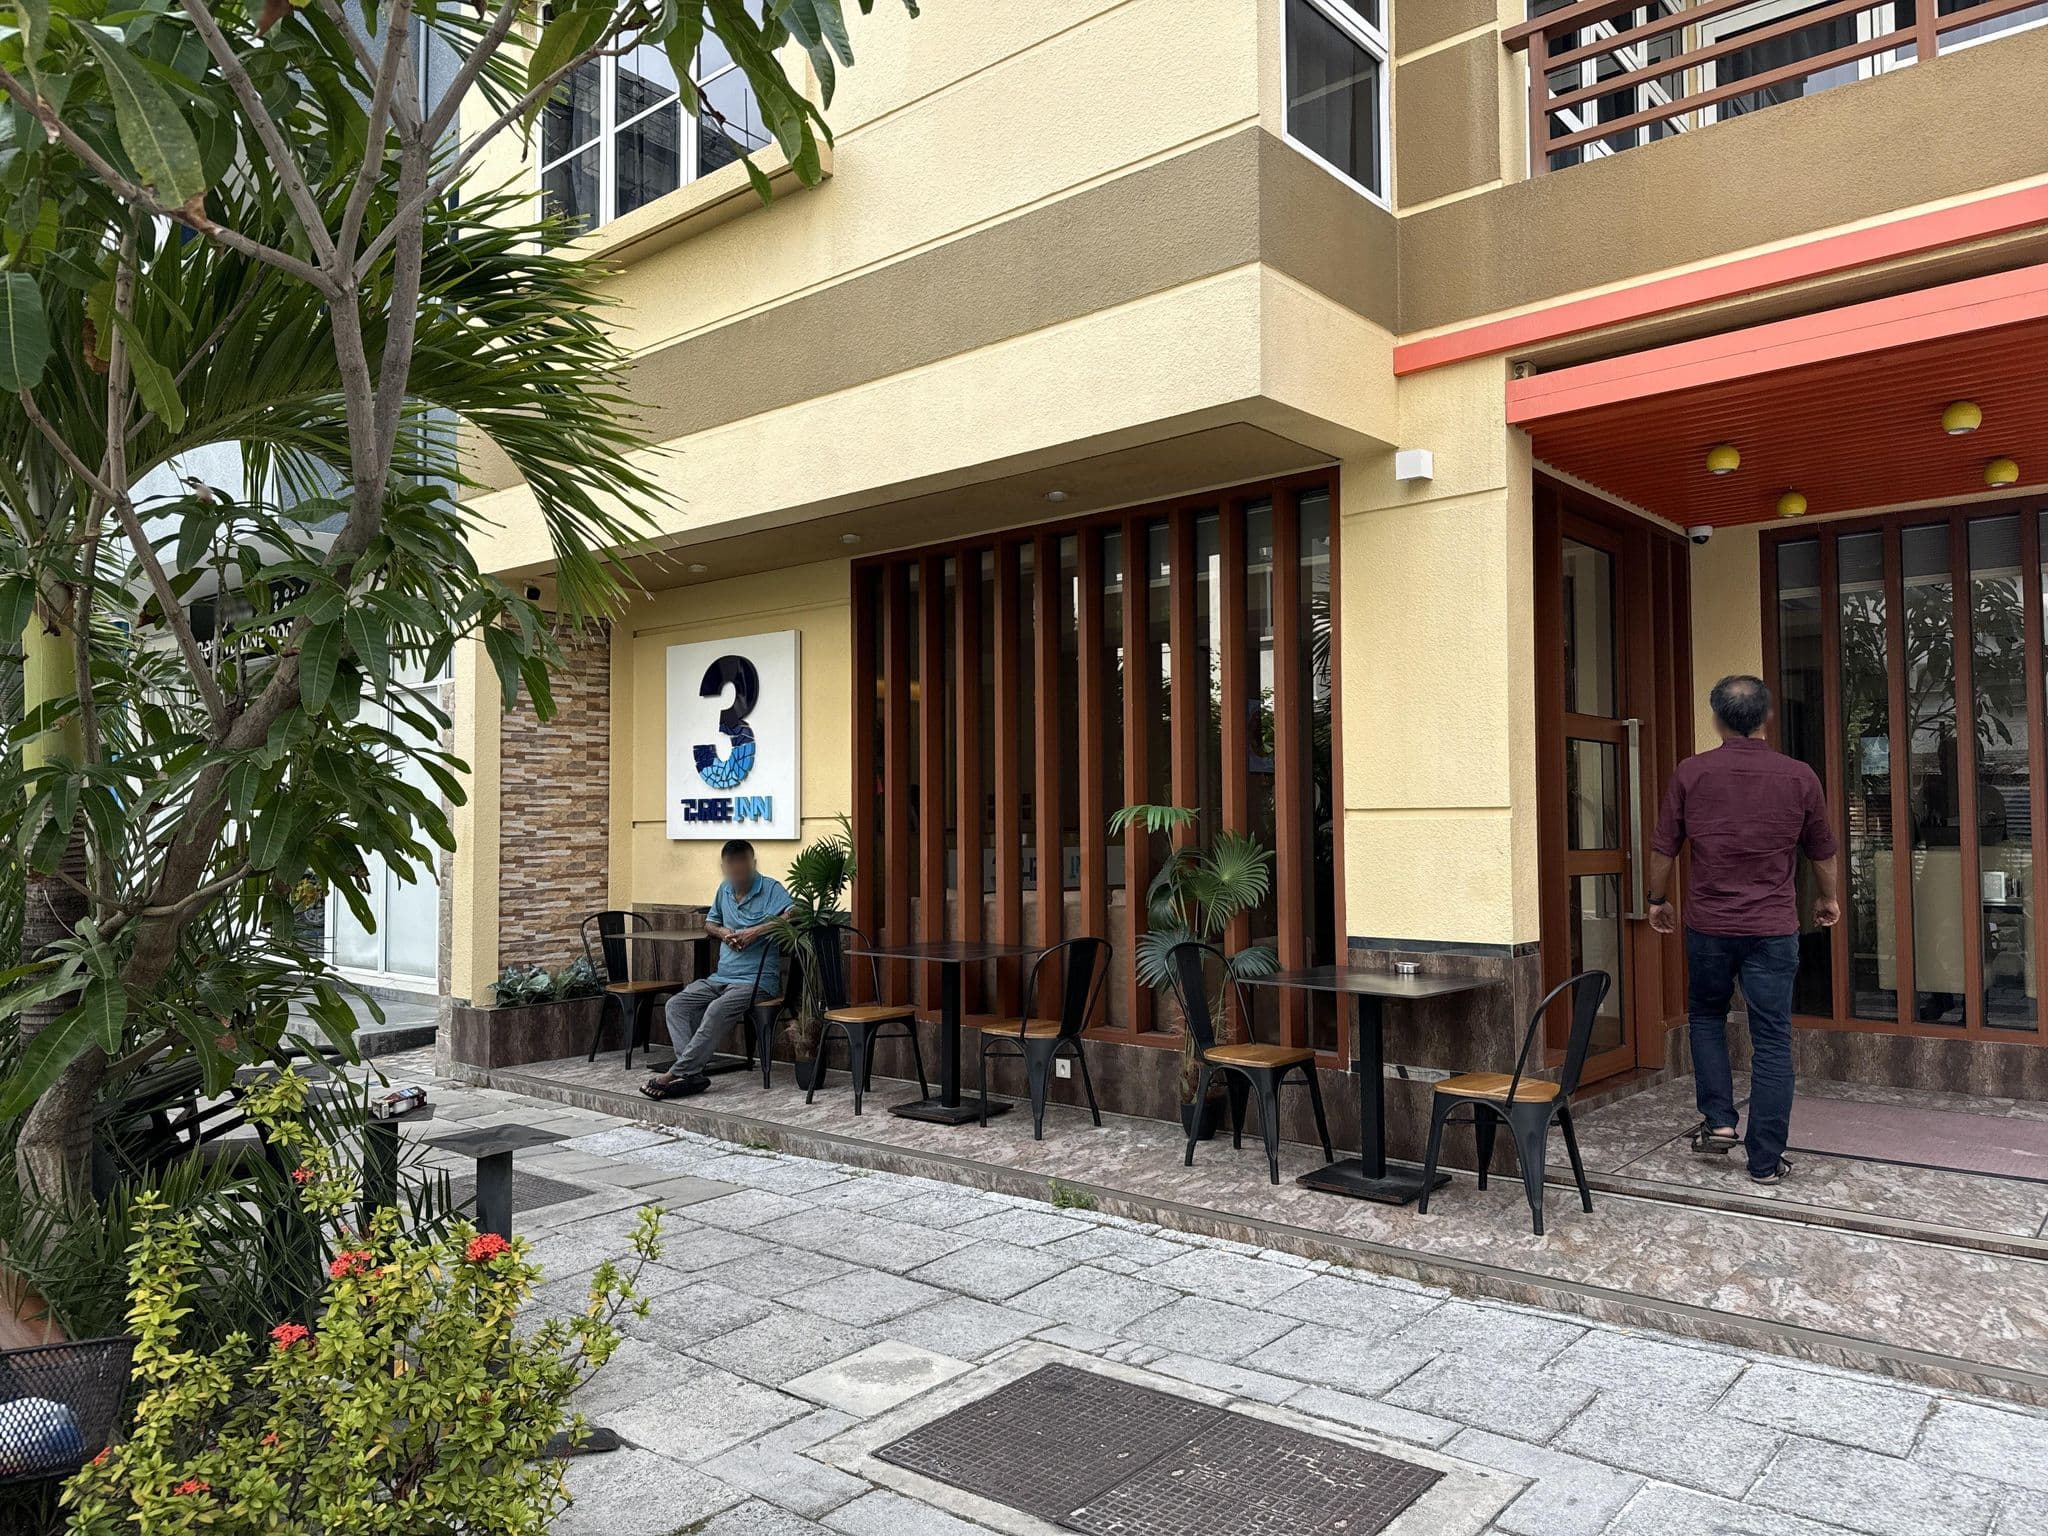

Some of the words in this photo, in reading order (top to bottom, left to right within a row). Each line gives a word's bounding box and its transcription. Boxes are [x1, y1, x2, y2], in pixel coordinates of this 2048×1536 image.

[693, 655, 759, 790] 3
[681, 798, 733, 821] THREE
[734, 796, 772, 823] INN
